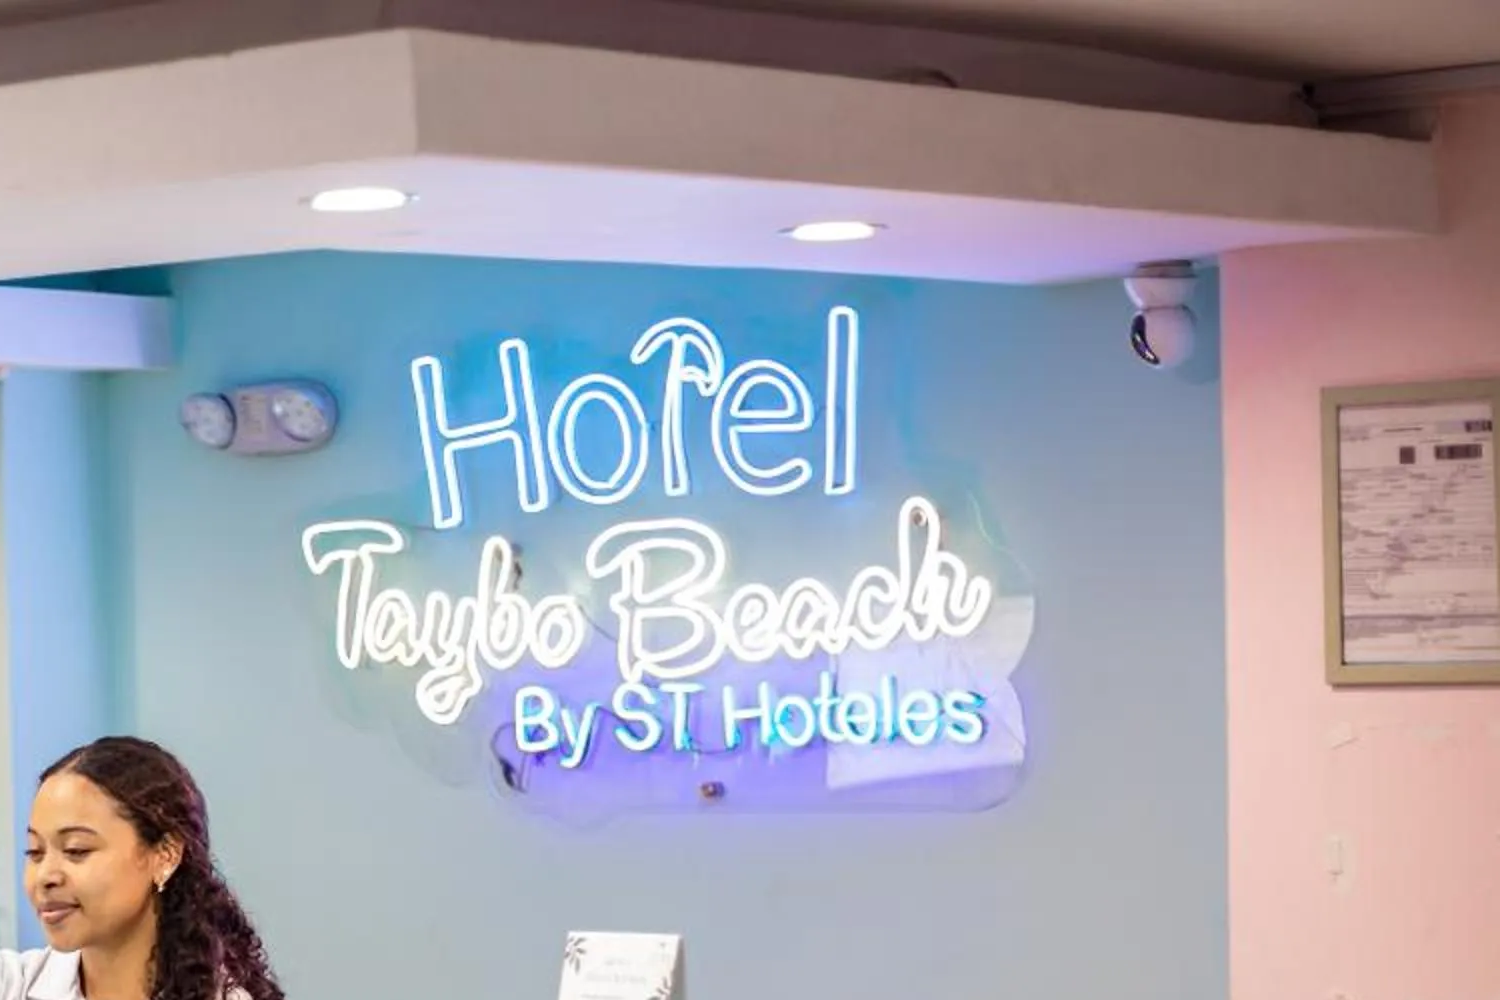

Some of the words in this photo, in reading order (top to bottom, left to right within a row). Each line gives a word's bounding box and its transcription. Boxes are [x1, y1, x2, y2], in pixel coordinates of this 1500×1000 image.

[411, 306, 859, 530] Hotel
[303, 520, 585, 724] Taybo
[587, 496, 992, 681] Beach
[514, 687, 599, 768] By
[614, 683, 705, 752] ST
[722, 671, 989, 750] Hoteles
